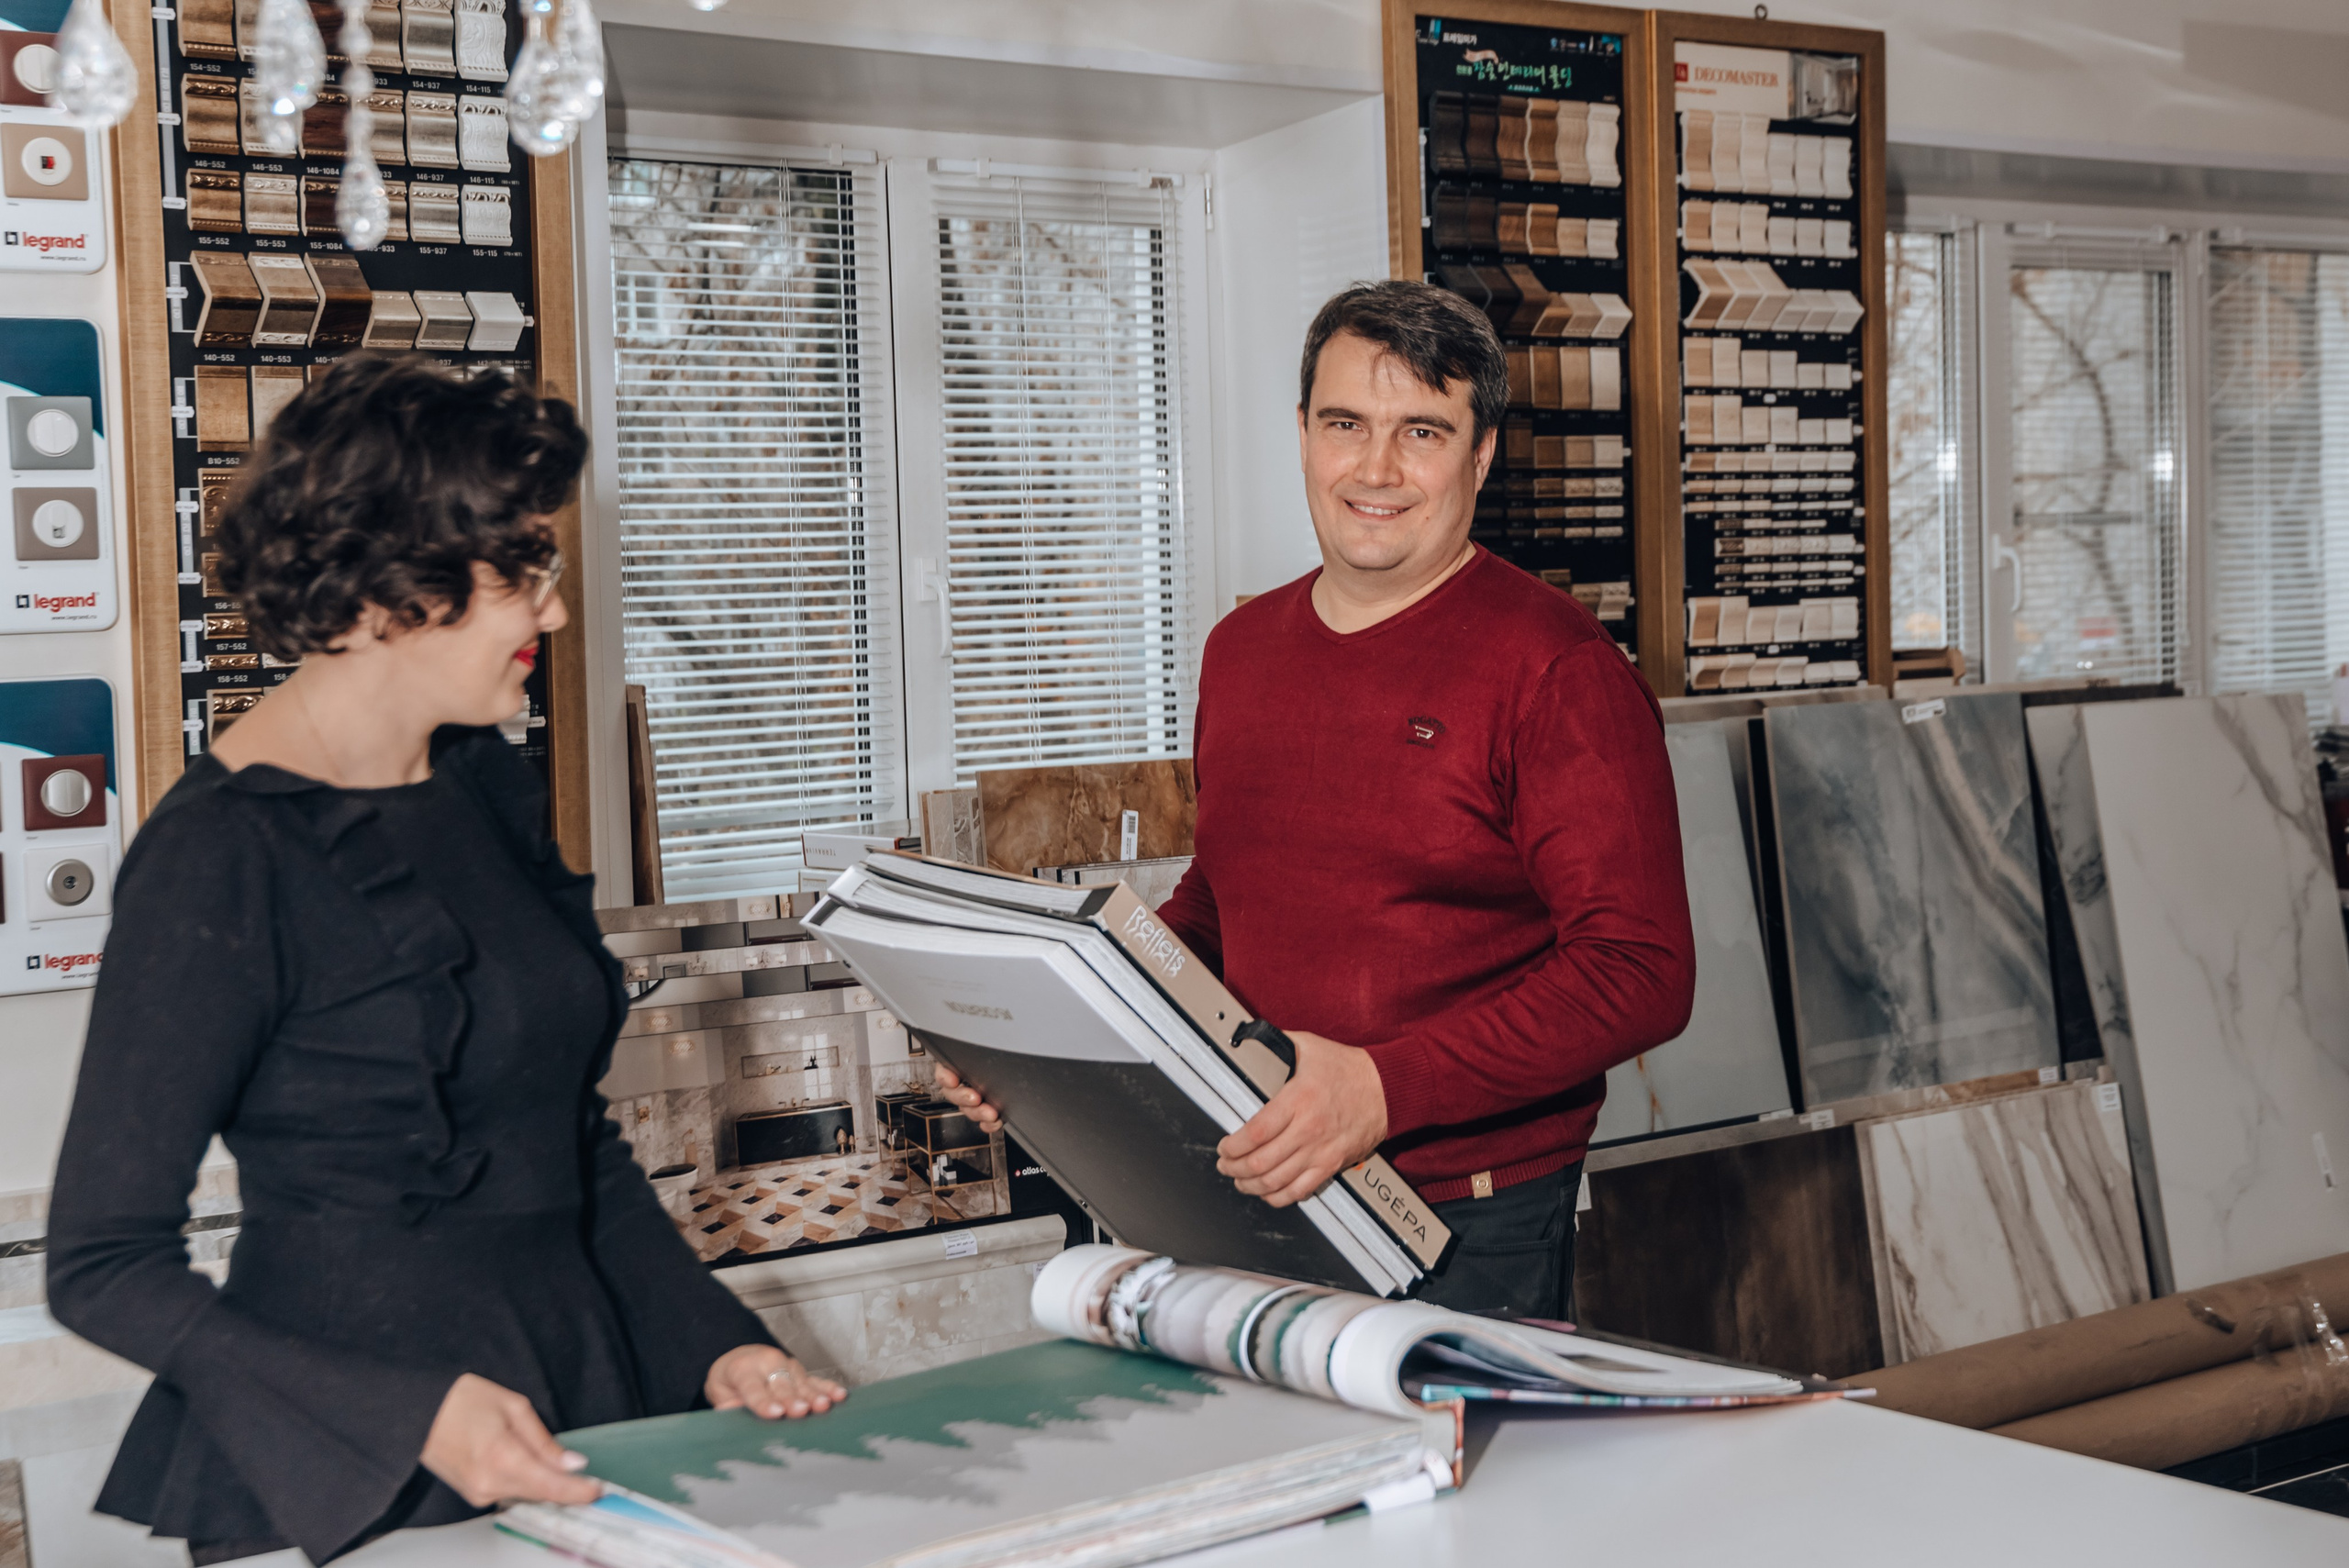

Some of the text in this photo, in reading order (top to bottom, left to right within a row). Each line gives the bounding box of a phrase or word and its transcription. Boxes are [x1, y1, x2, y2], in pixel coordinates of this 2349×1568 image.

[190, 63, 221, 72] 154-552
[1695, 66, 1778, 87] DECOMASTER
[413, 81, 440, 90] 154-937
[466, 84, 492, 94] 154-115
[195, 160, 226, 169] 146-552
[252, 163, 283, 172] 146-553
[306, 166, 340, 176] 146-1084
[417, 173, 444, 182] 146-937
[470, 176, 495, 184] 146-115
[23, 231, 85, 251] legrand
[198, 237, 229, 246] 155-552
[256, 239, 286, 248] 155-553
[310, 241, 342, 250] 155-1084
[419, 247, 448, 255] 155-937
[473, 249, 498, 257] 155-115
[204, 354, 235, 362] 140-552
[261, 355, 292, 363] 140-553
[34, 593, 95, 612] legrand
[217, 675, 248, 684] 158-552
[1121, 905, 1186, 975] Reflets
[1022, 1166, 1040, 1175] atlas
[1364, 1168, 1426, 1243] UGÉPA
